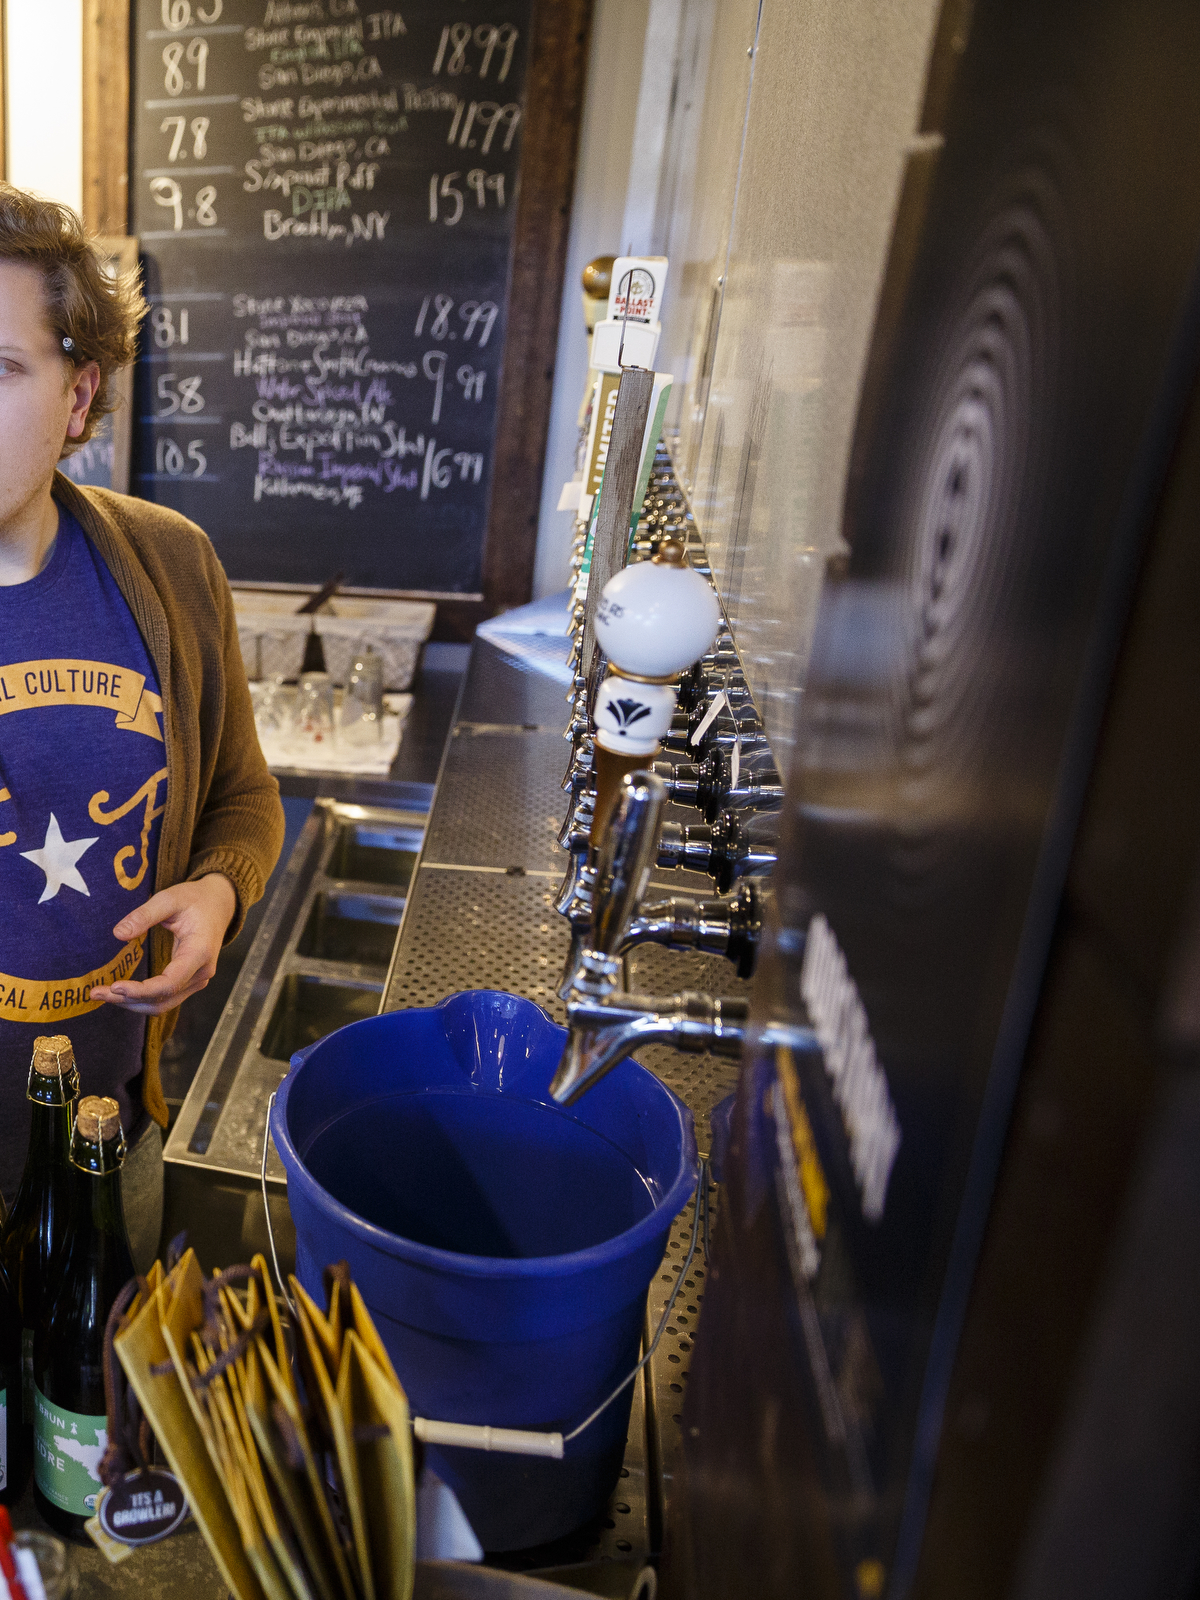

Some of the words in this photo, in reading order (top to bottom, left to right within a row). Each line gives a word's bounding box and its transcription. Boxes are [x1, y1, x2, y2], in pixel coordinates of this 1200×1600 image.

[162, 37, 210, 96] 8.9
[160, 116, 211, 162] 7.8
[149, 177, 218, 232] 9.8
[415, 293, 499, 347] 18.99
[619, 306, 647, 316] POINT
[25, 669, 122, 699] CULTURE
[39, 1403, 65, 1430] BRUN
[37, 1439, 65, 1472] IDRE
[154, 1489, 164, 1504] A
[113, 1502, 176, 1529] GROWLER!
